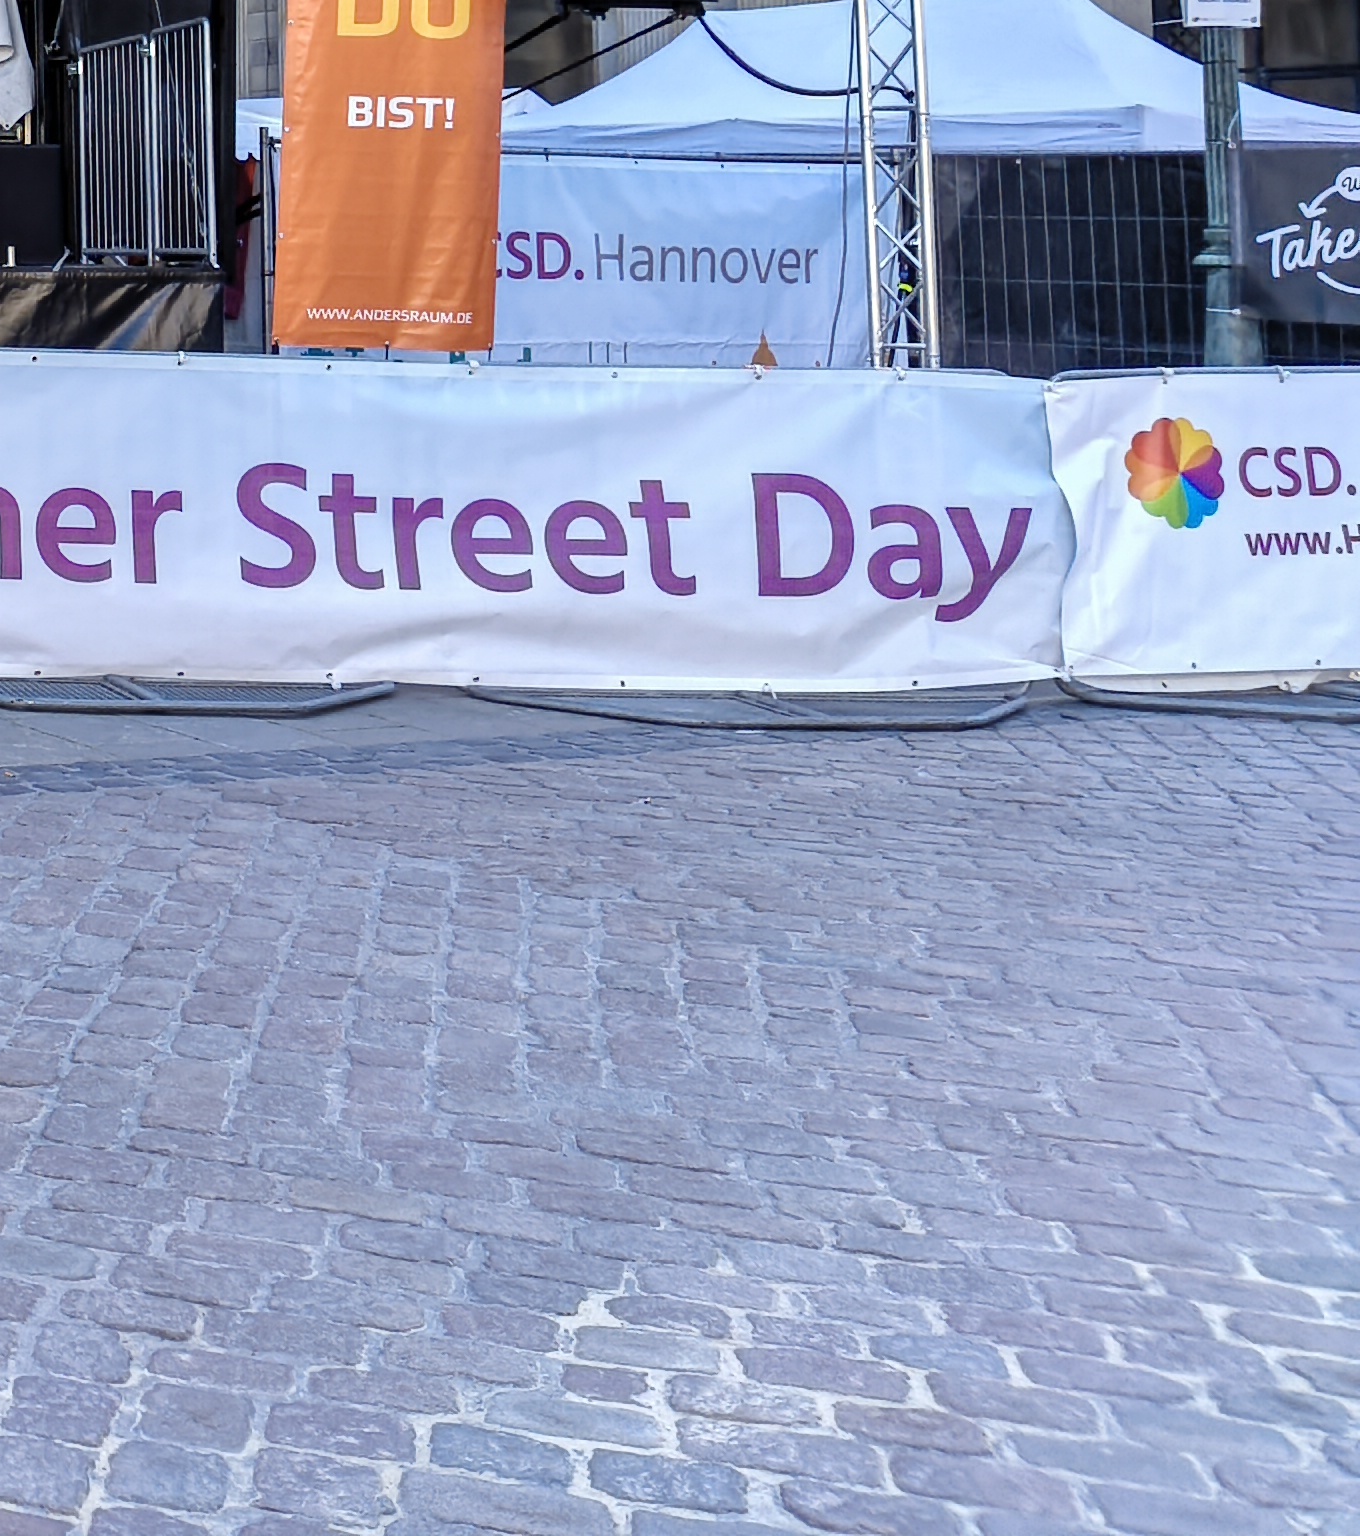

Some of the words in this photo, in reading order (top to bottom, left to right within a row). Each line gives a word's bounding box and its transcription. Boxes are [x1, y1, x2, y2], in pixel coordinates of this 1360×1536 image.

[347, 95, 455, 129] BIST!
[594, 232, 819, 285] Hannover
[306, 307, 473, 325] WWW.ANDERSRAUM.DE
[1239, 446, 1357, 497] CSD.
[236, 461, 697, 598] Street
[754, 471, 1034, 625] Day
